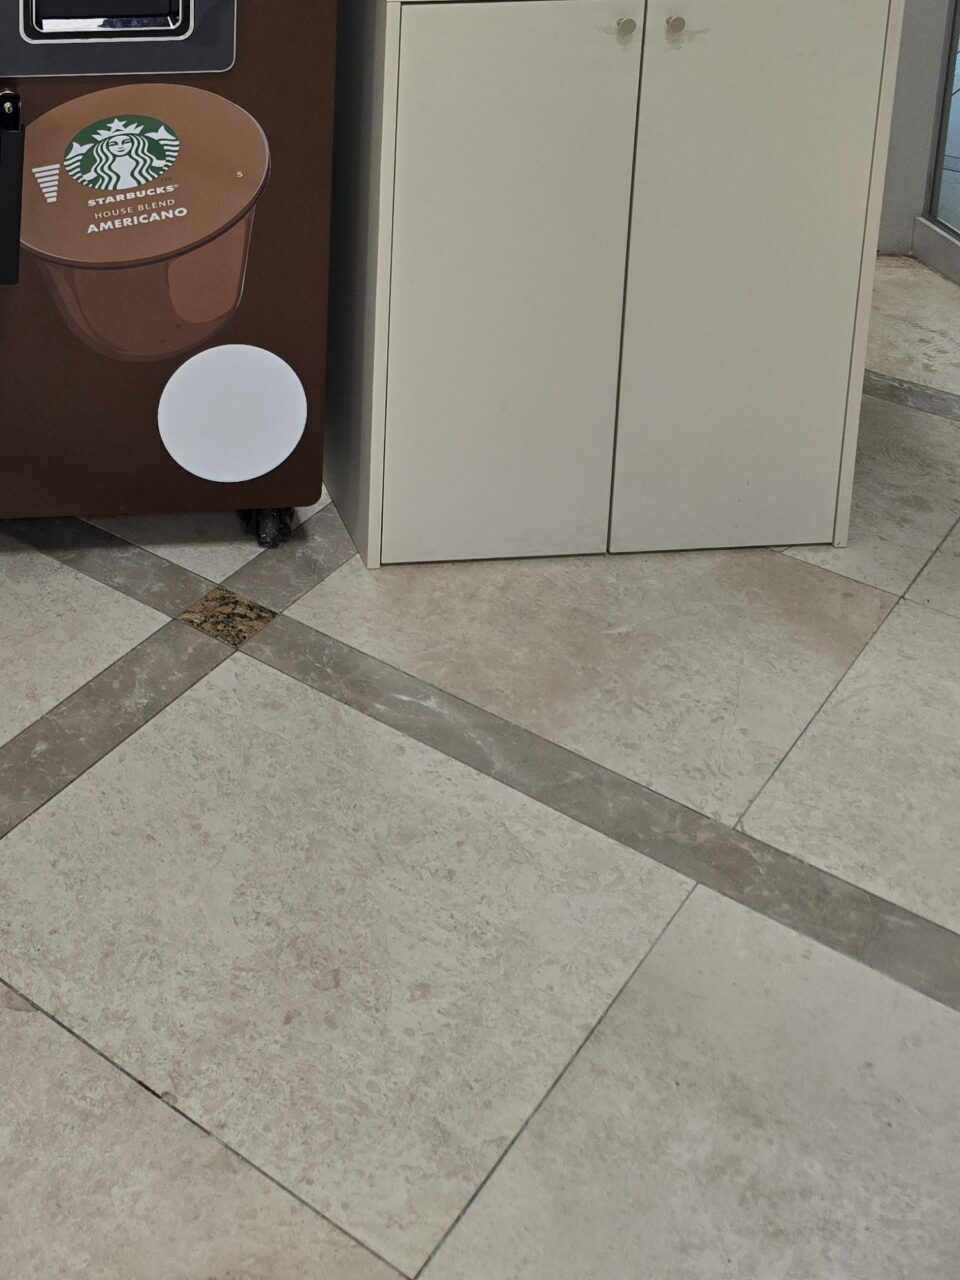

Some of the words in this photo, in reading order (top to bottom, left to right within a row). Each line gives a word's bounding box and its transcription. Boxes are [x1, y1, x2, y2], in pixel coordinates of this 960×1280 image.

[87, 184, 175, 207] STARBUCKS
[87, 207, 188, 233] AMERICANO
[94, 206, 134, 219] HOUSE
[138, 199, 175, 211] BLEND
